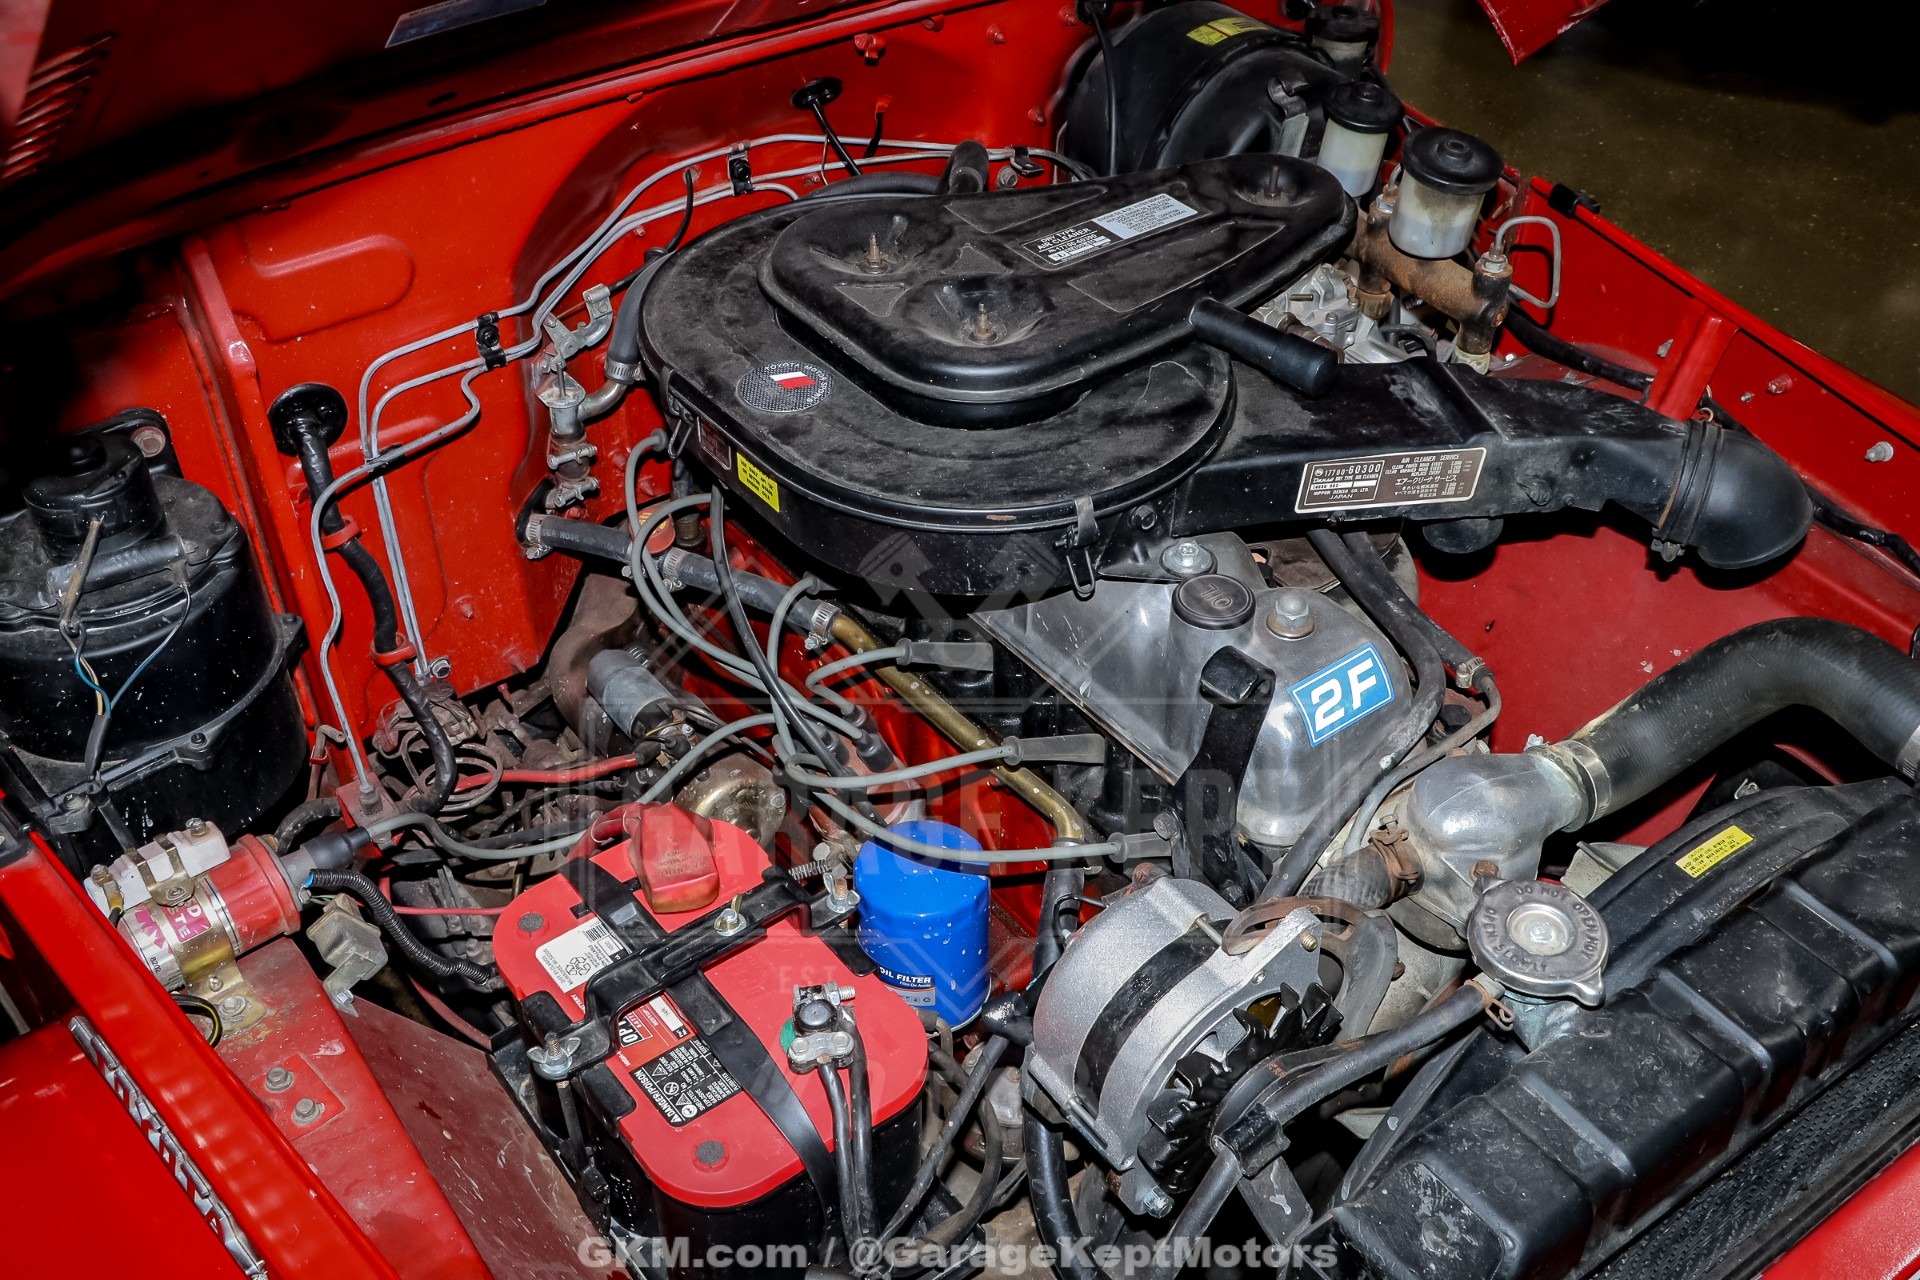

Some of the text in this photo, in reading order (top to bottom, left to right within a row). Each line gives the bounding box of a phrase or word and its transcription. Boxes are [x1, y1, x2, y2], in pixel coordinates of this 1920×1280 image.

[1037, 241, 1053, 250] AIR
[1052, 227, 1091, 244] CLEANER
[1041, 227, 1075, 243] DRY TYPE
[764, 362, 800, 371] TOYOTA
[559, 531, 580, 542] HOSE
[1310, 657, 1377, 733] 2F
[880, 966, 932, 984] OIL FILTER
[631, 1069, 678, 1117] DANGER/POISON
